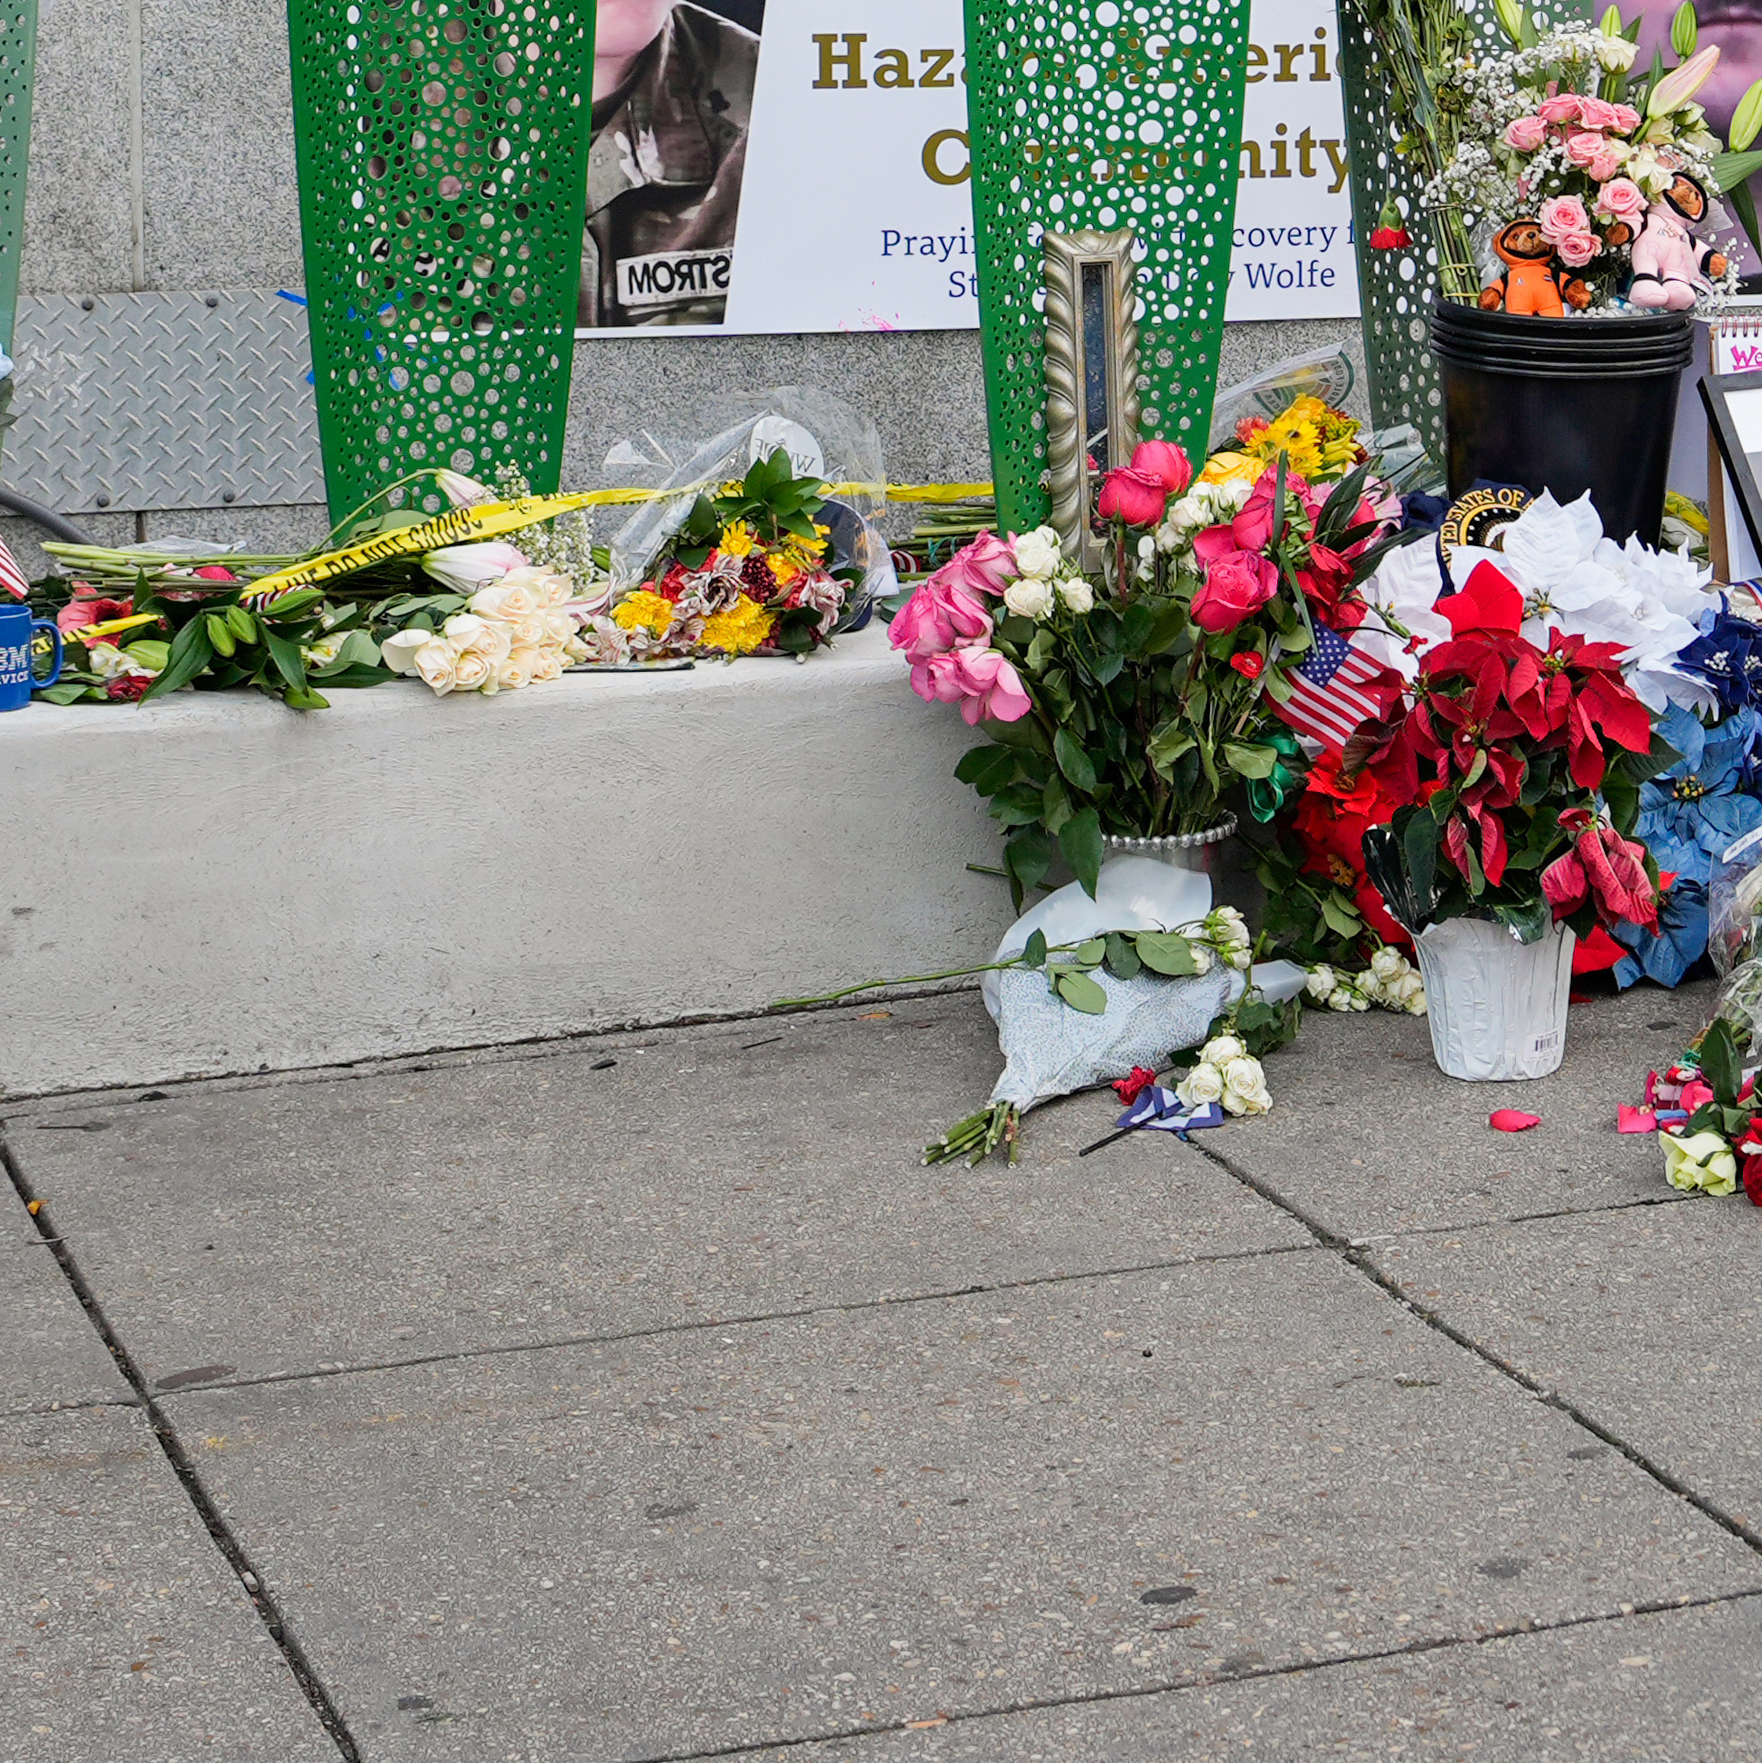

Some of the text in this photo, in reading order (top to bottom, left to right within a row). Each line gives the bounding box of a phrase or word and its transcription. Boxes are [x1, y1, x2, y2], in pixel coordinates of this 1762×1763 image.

[881, 229, 976, 260] Prayi
[1231, 224, 1327, 255] covery
[1245, 260, 1336, 289] Wolfe
[1446, 488, 1496, 521] STATES
[1498, 488, 1524, 507] OF
